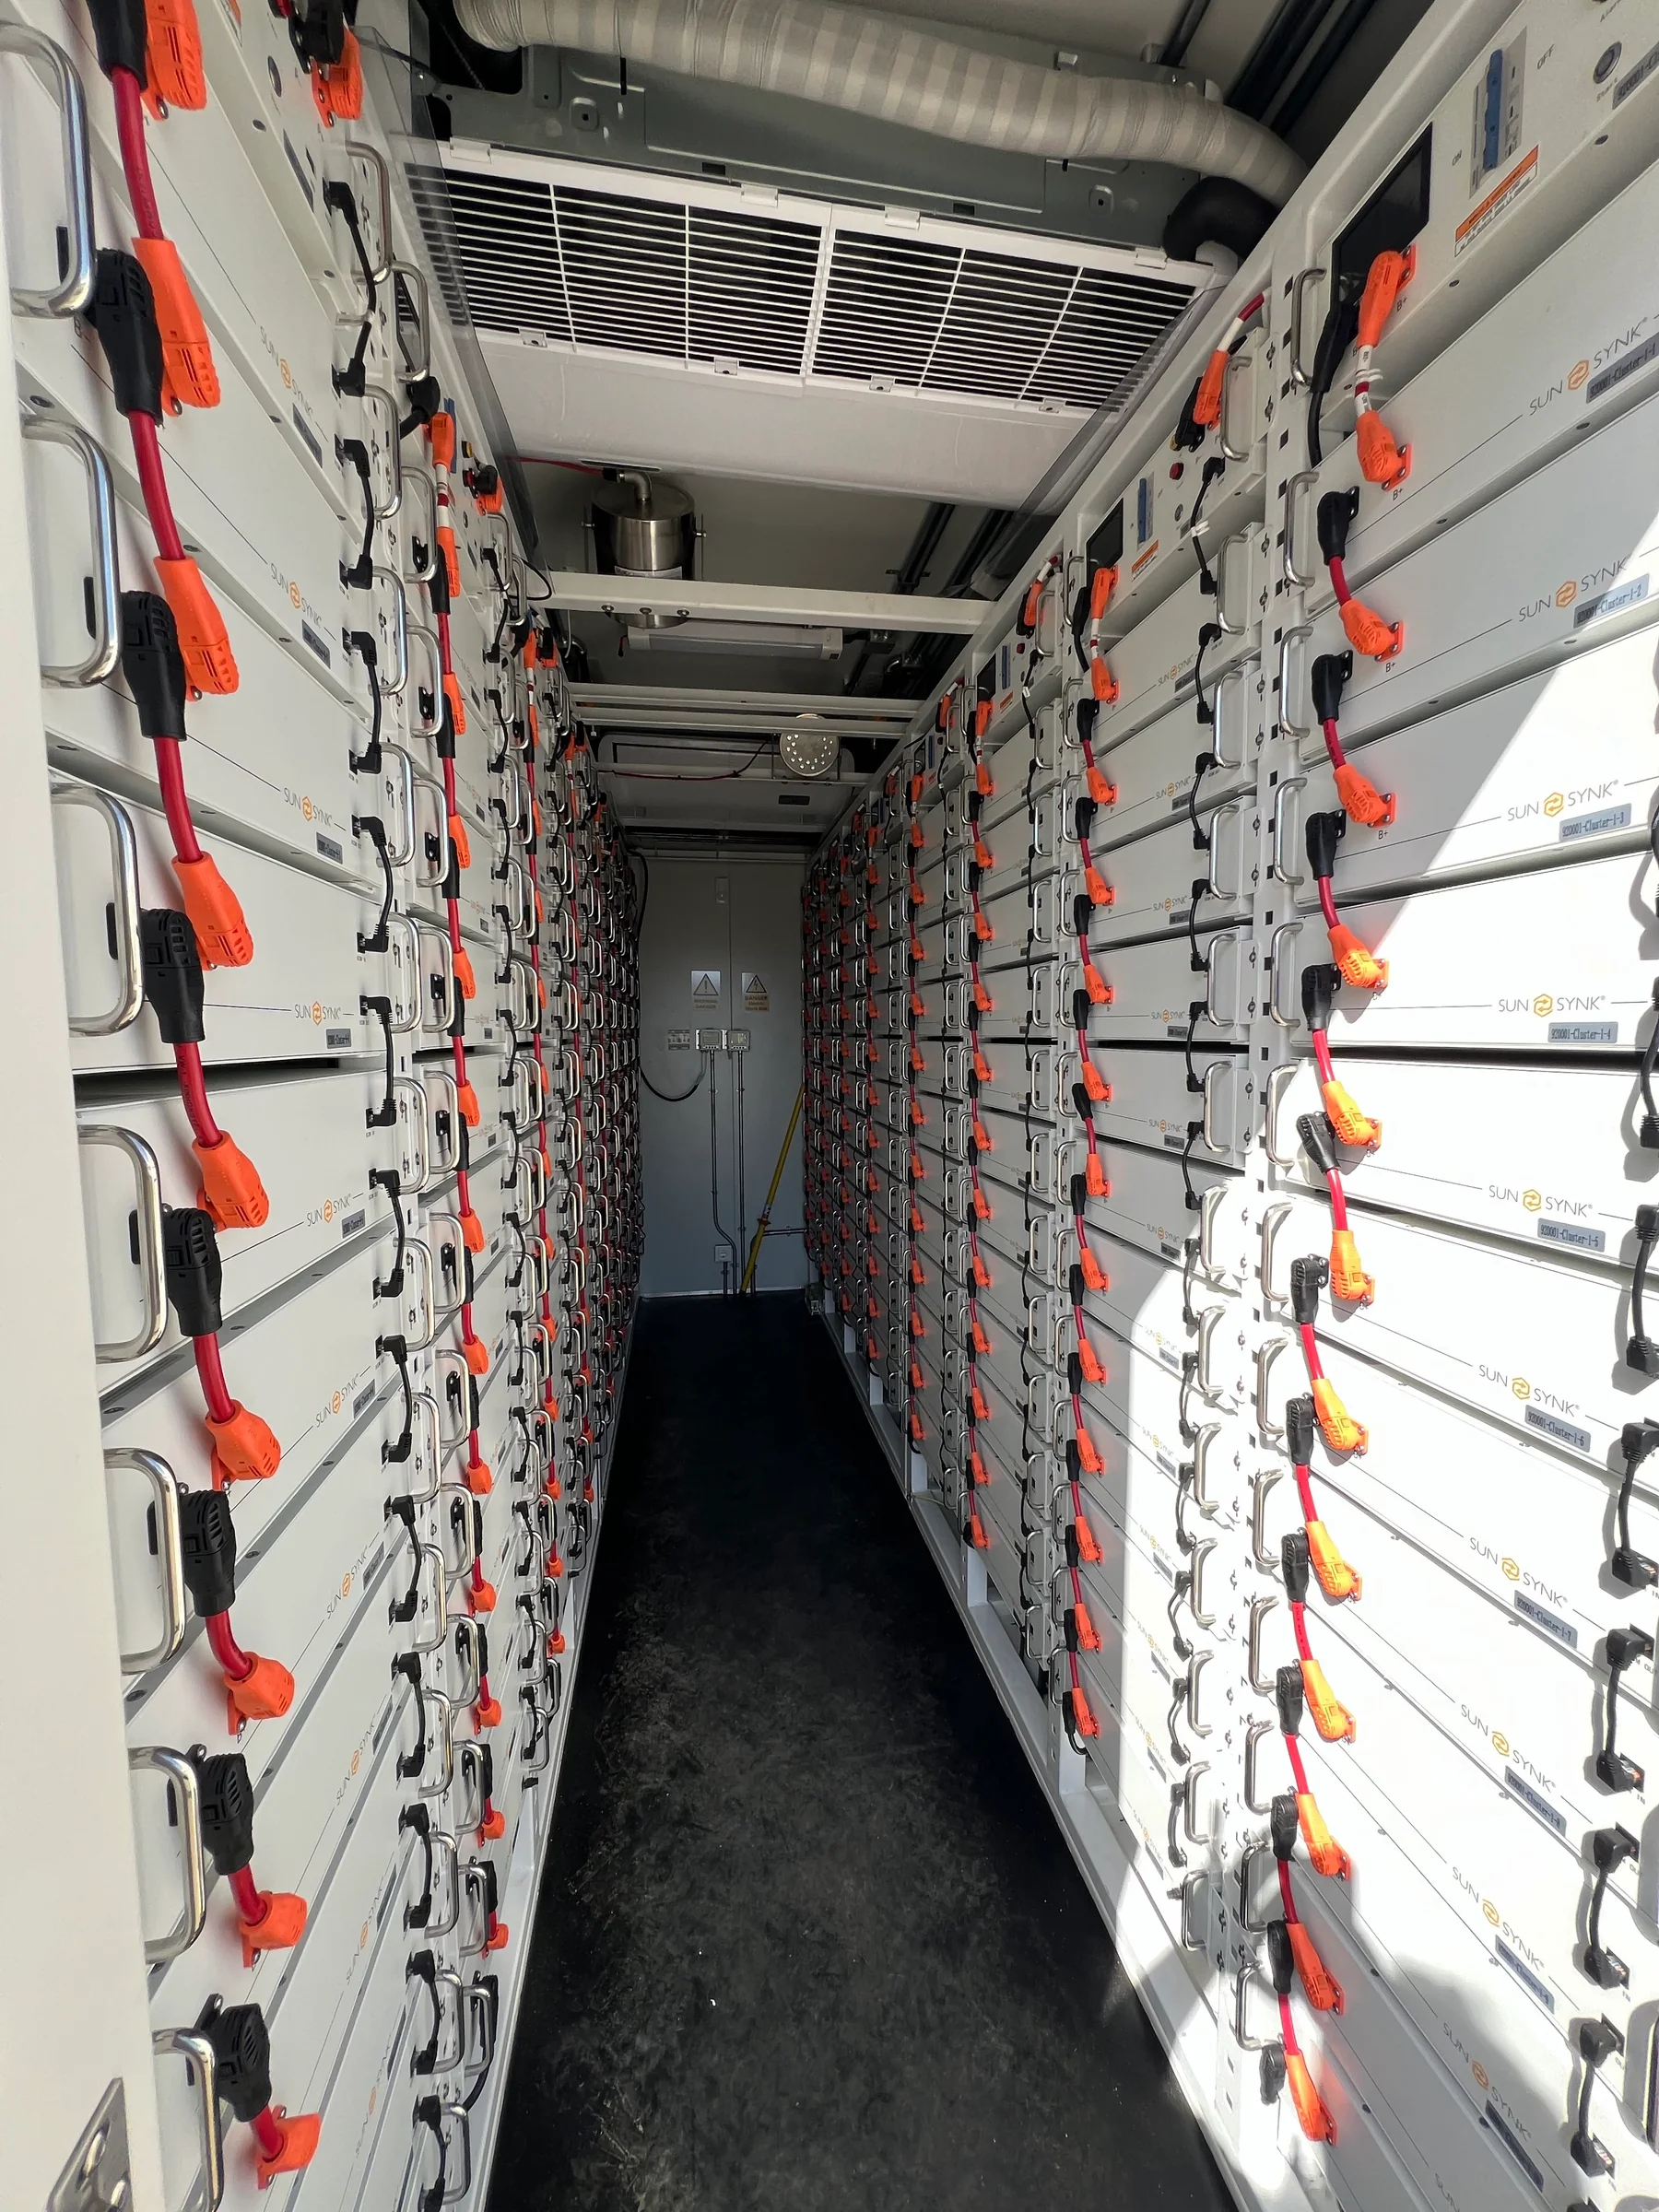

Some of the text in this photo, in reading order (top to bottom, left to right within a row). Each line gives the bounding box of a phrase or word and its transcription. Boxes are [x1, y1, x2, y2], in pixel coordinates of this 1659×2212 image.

[1537, 43, 1554, 69] OFF
[1452, 149, 1462, 166] ON
[1396, 298, 1407, 312] B+
[1529, 321, 1641, 416] SUN SYNK
[1393, 488, 1404, 500] B+
[270, 562, 289, 594] SUN
[1519, 555, 1629, 622] SUN SYNK
[1385, 663, 1396, 673] B+
[283, 787, 301, 810] SUN
[1508, 782, 1615, 822] SUN SYNK
[1378, 830, 1389, 840] B+
[294, 1004, 312, 1018] SUN
[1499, 996, 1601, 1012] SUN SYNK
[1488, 1184, 1588, 1218] SUN SYNK
[307, 1207, 323, 1227] SUN
[1479, 1364, 1575, 1417] SUN SYNK
[315, 1402, 332, 1428] SUN
[1470, 1537, 1563, 1608] SUN SYNK
[1461, 1704, 1551, 1793] SUN SYNK
[1453, 1866, 1479, 1903] SUN
[1443, 2021, 1469, 2063] SUN
